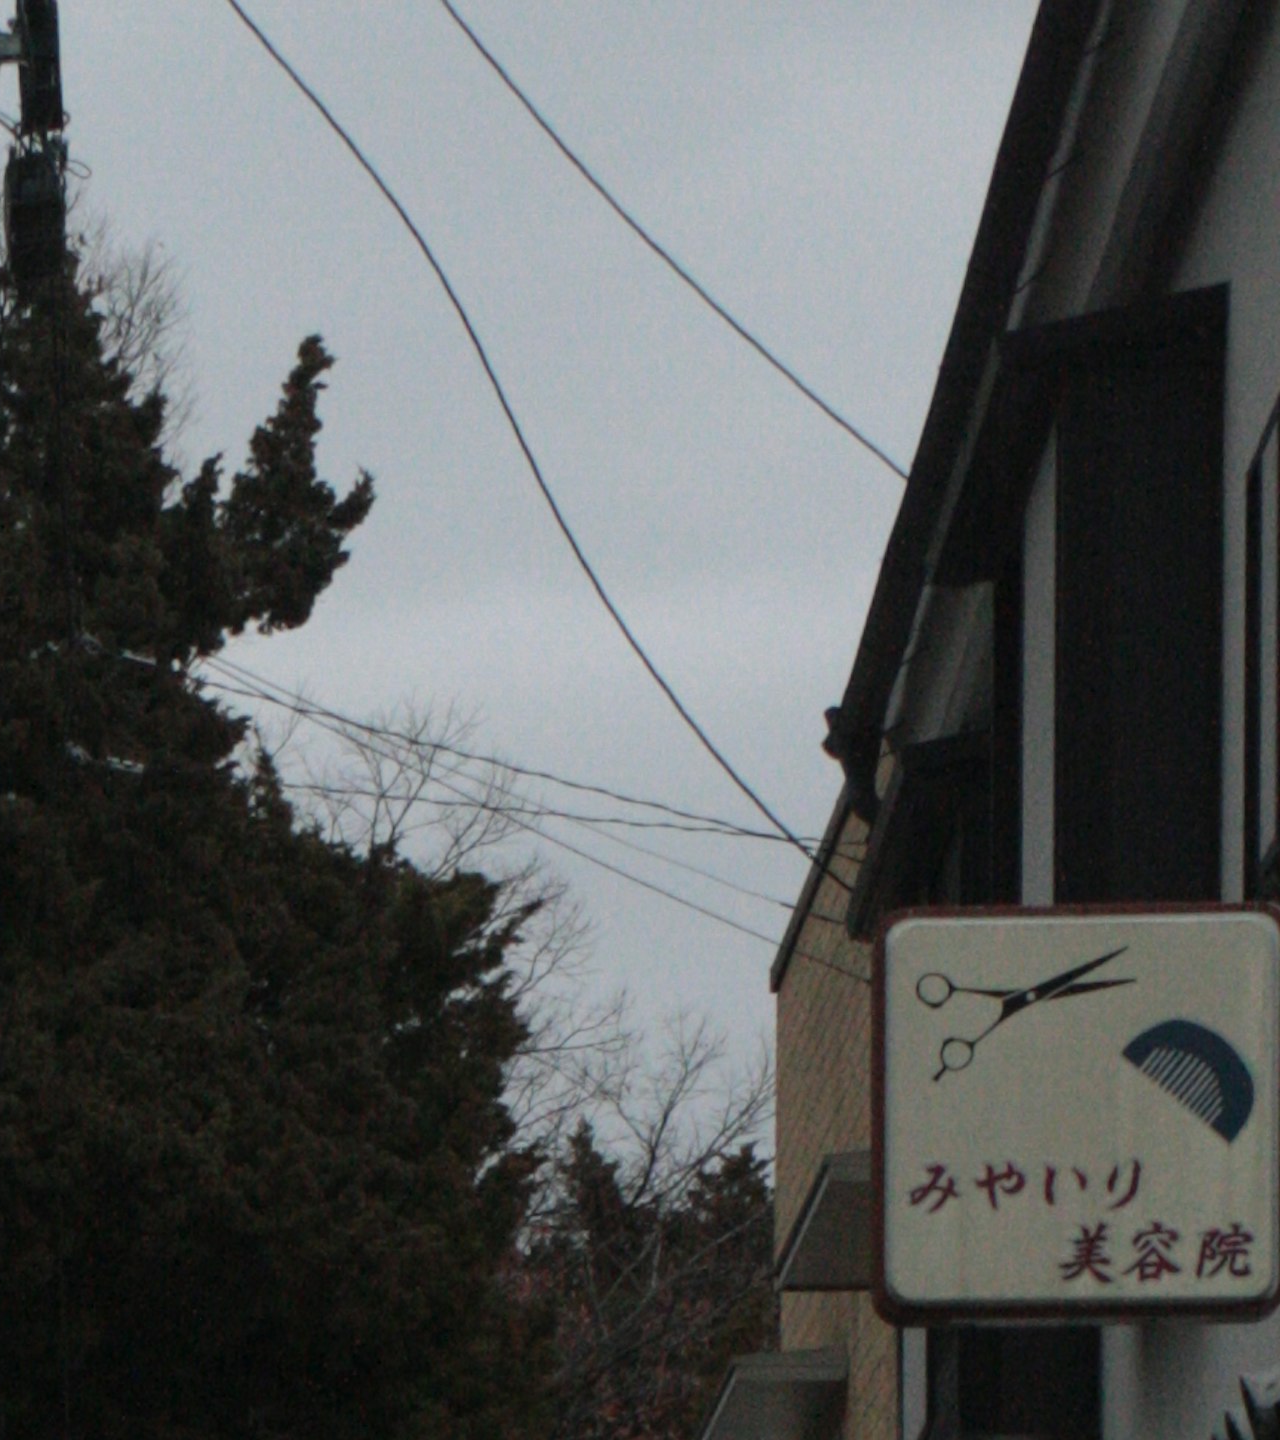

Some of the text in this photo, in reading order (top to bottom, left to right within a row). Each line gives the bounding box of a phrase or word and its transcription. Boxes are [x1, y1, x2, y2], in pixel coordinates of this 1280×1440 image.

[909, 1159, 1141, 1213] みやいり
[1057, 1222, 1254, 1283] 美容院
